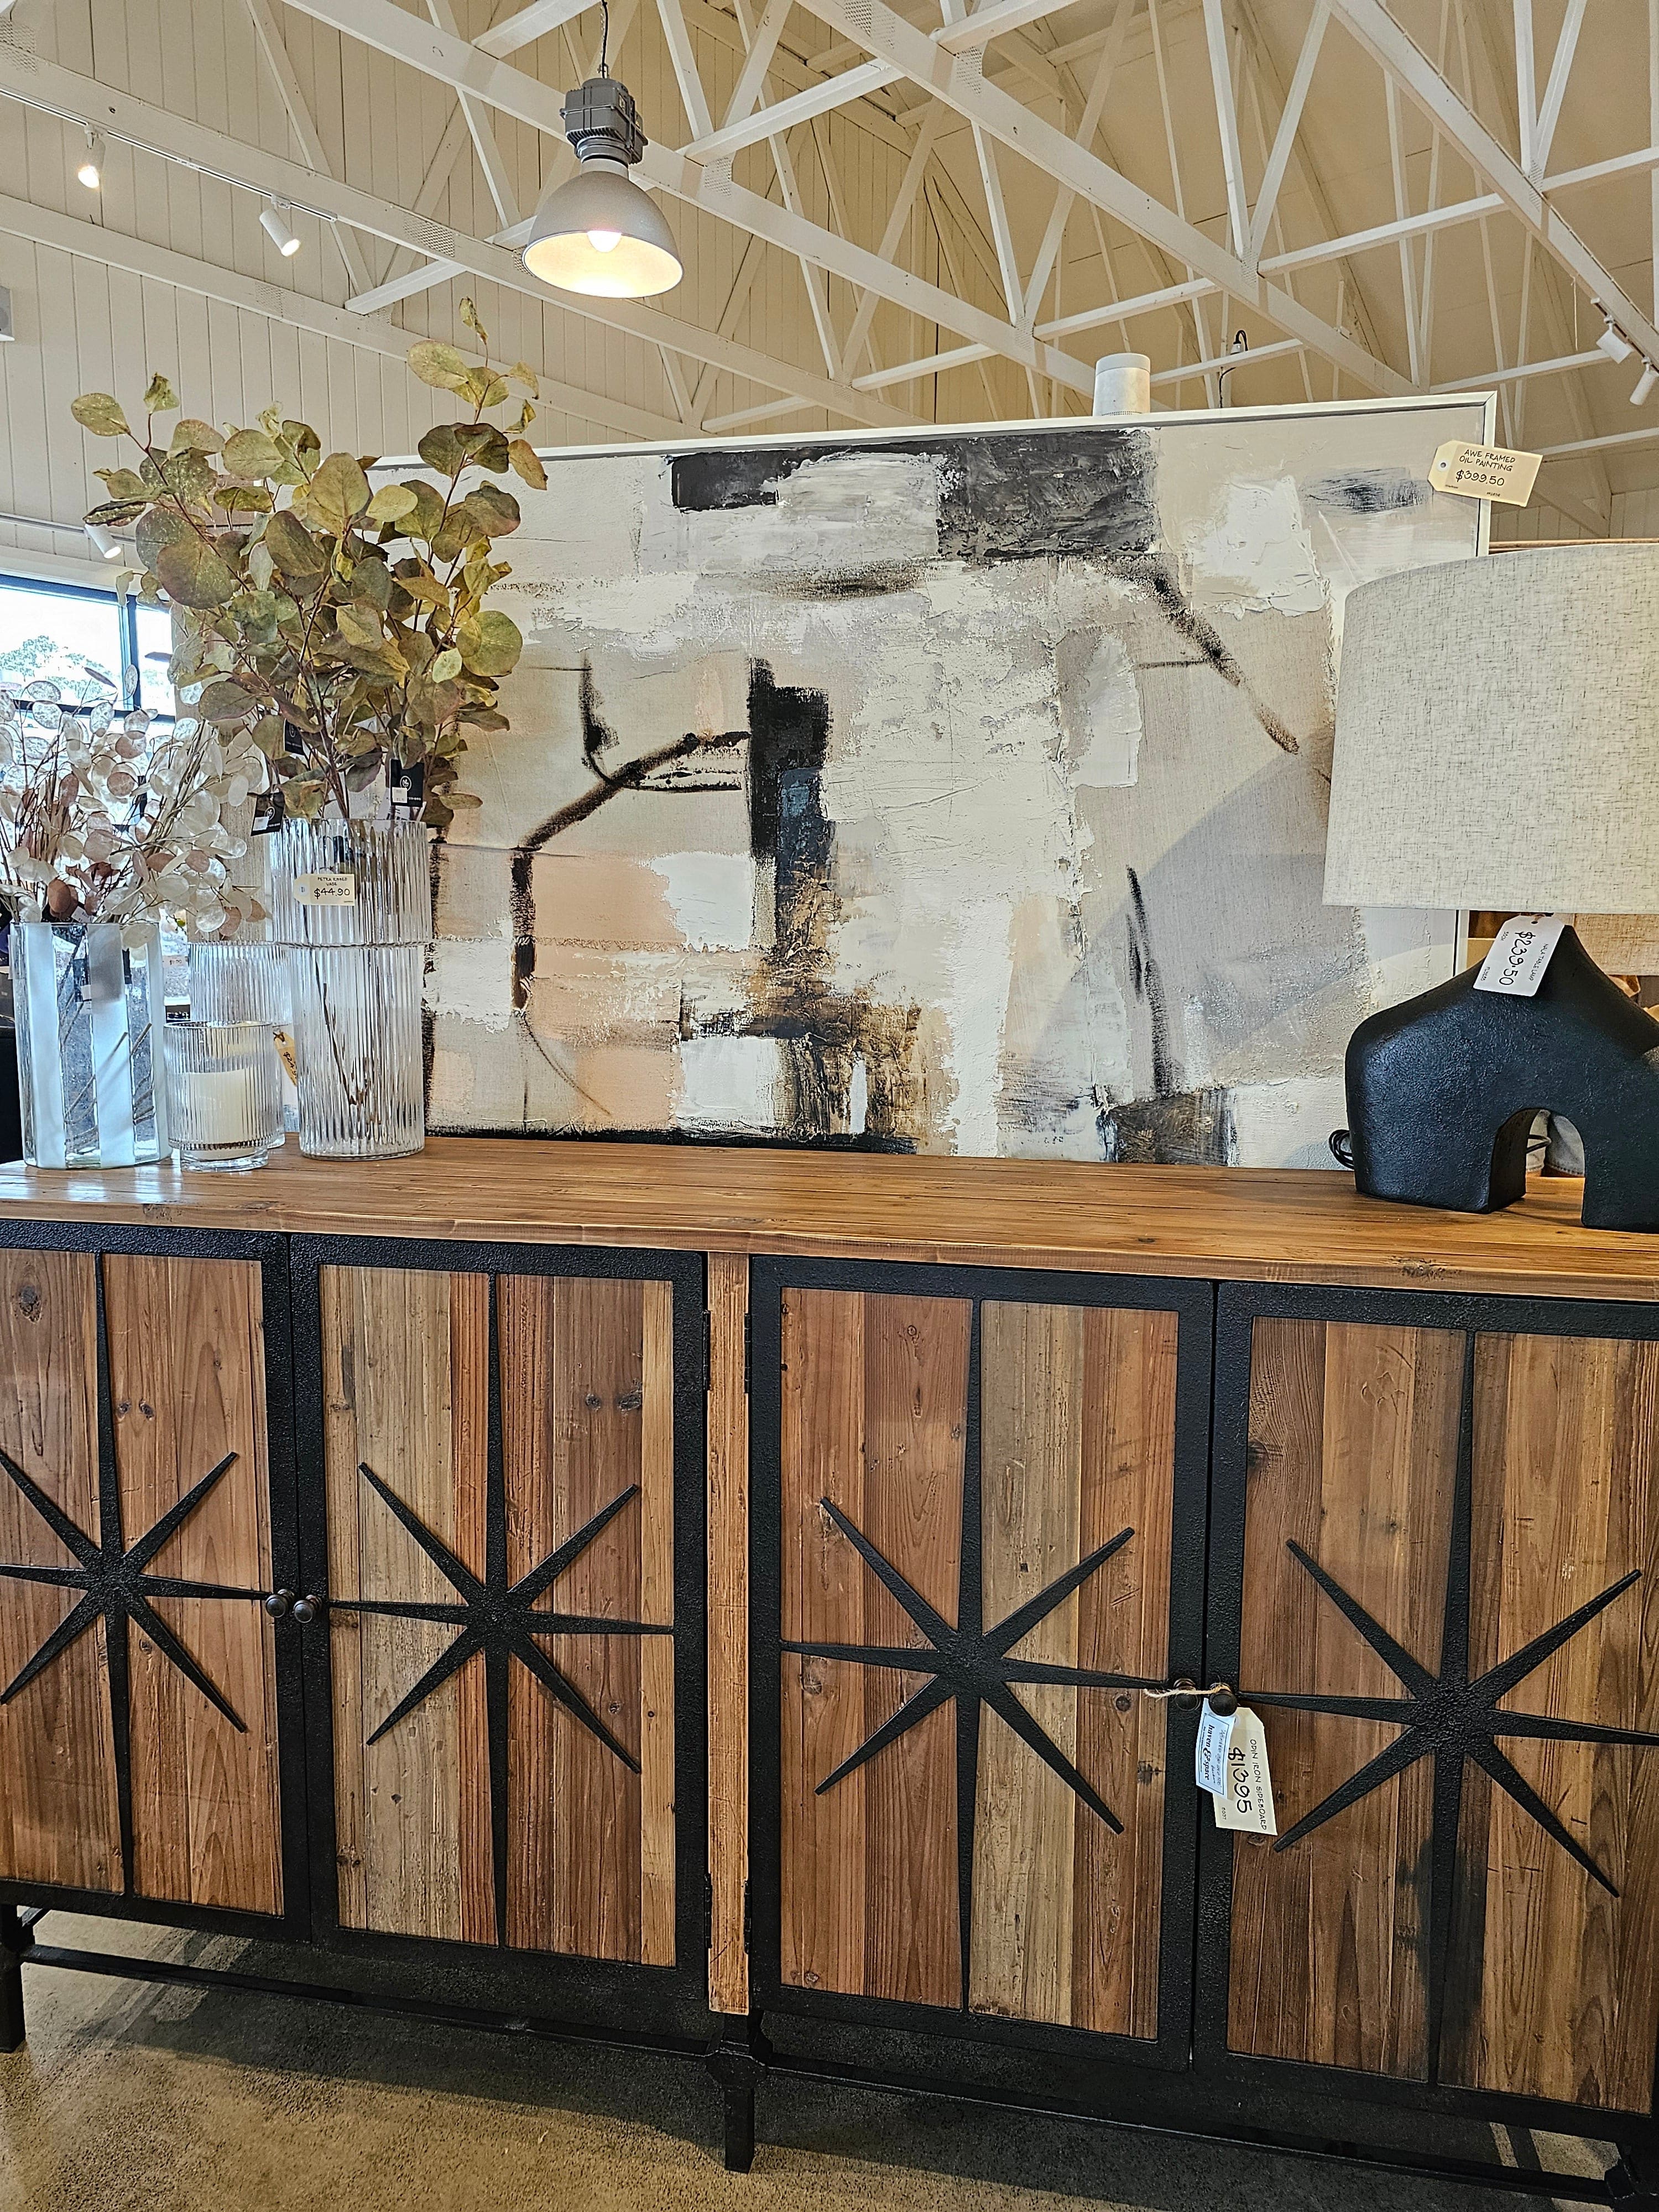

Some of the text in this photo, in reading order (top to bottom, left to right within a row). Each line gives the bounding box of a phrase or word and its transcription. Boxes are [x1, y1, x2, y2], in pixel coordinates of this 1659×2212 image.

[1459, 455, 1513, 472] OIL PAINTING
[1464, 449, 1516, 463] AWE FRAMED
[1455, 469, 1505, 486] $399.50
[314, 888, 350, 900] $44.90
[1499, 931, 1536, 985] $239.50
[1206, 1724, 1215, 1747] haven
[1202, 1747, 1212, 1762] &
[1227, 1747, 1253, 1813] $1395
[1250, 1739, 1267, 1831] ODIN IRON SIDEBOARD
